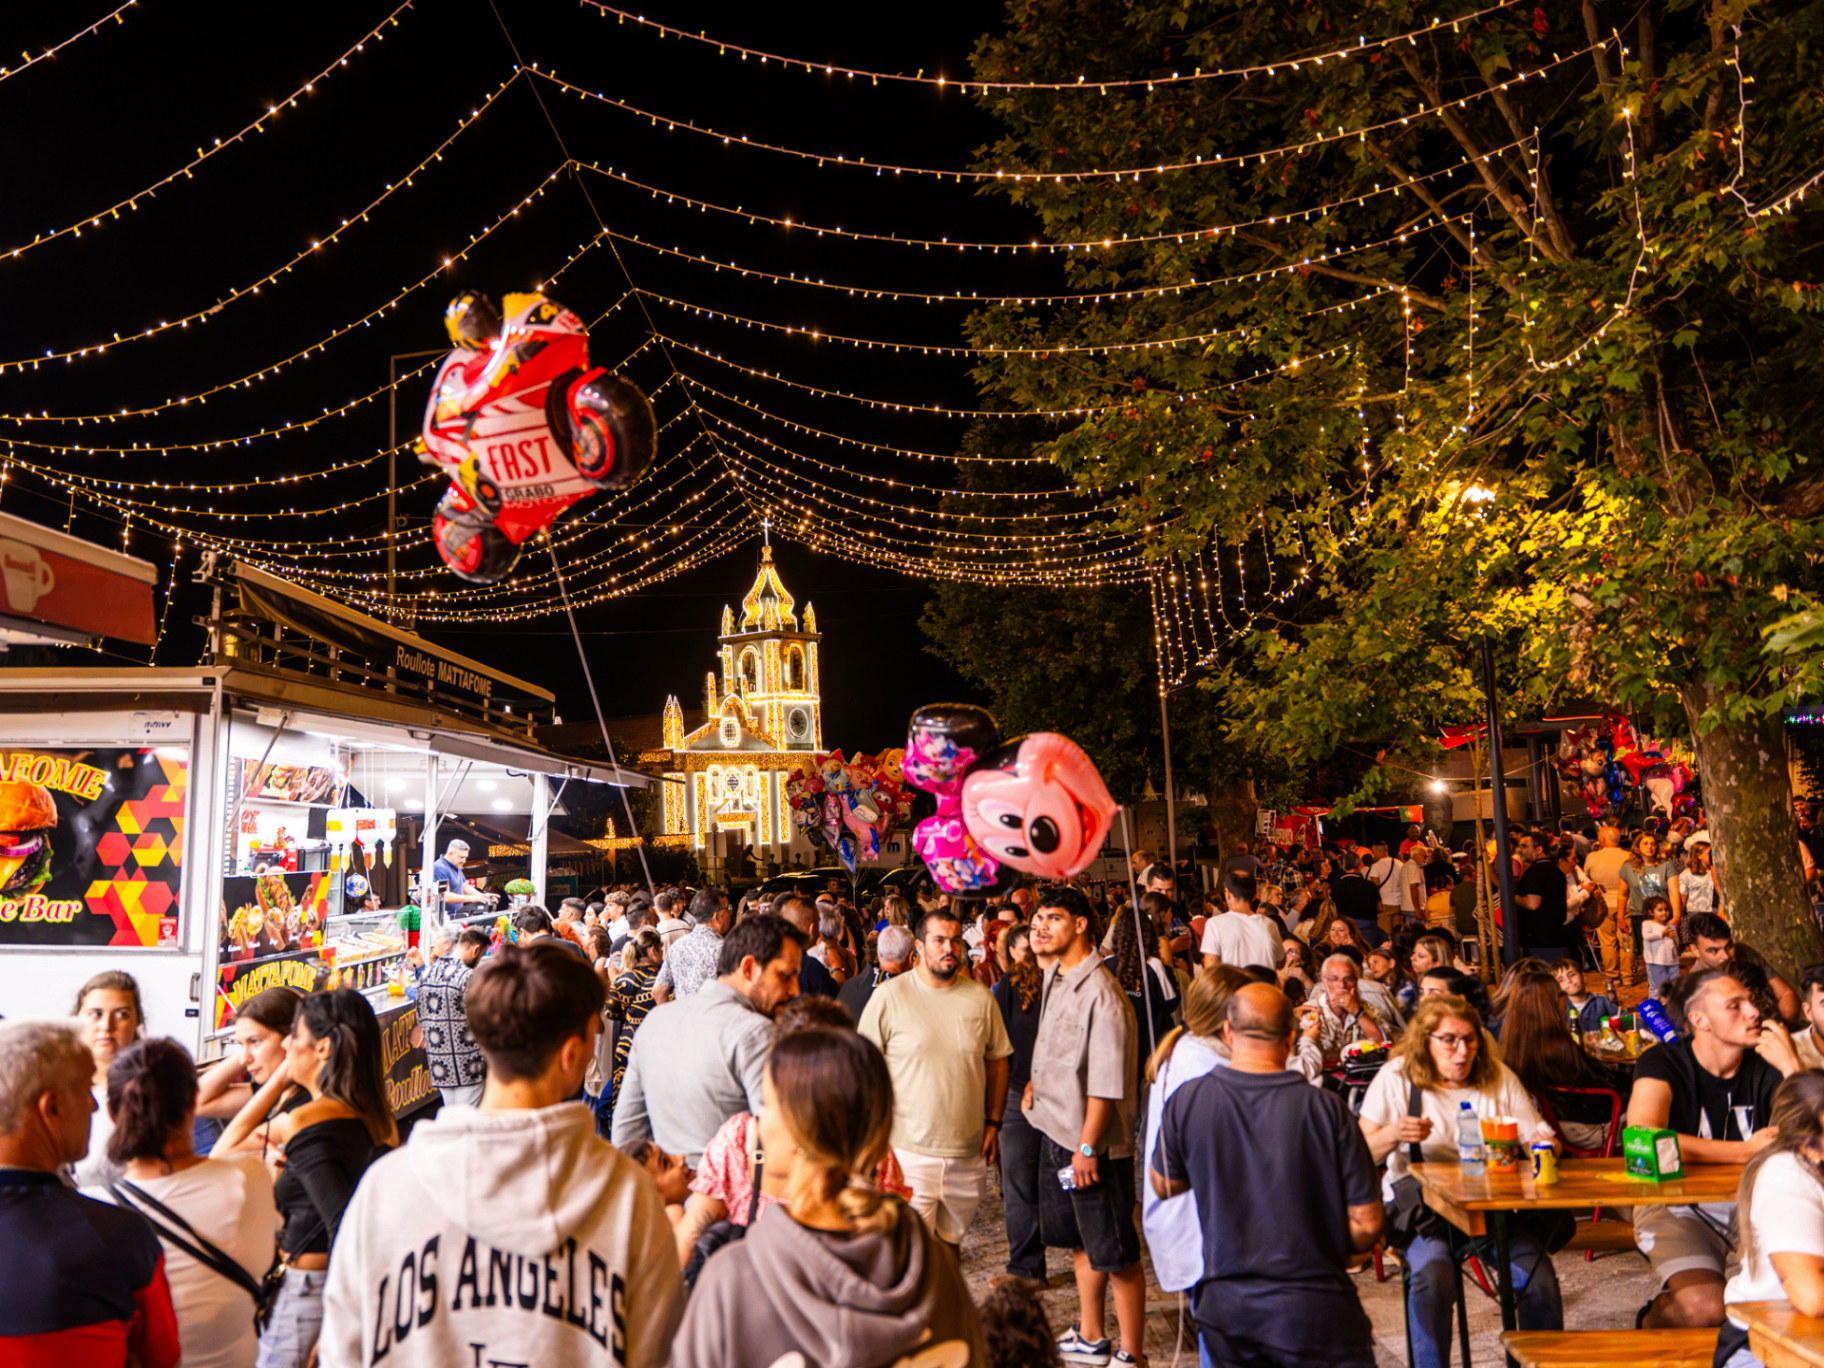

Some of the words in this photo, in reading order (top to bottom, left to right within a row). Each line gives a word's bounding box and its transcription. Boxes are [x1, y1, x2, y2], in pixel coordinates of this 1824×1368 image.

[487, 436, 551, 482] FAST
[396, 645, 435, 678] Roullote
[437, 660, 492, 698] MATTAFOME
[19, 894, 83, 923] Bar
[370, 1233, 441, 1368] LOS
[451, 1234, 627, 1368] ANGELES
